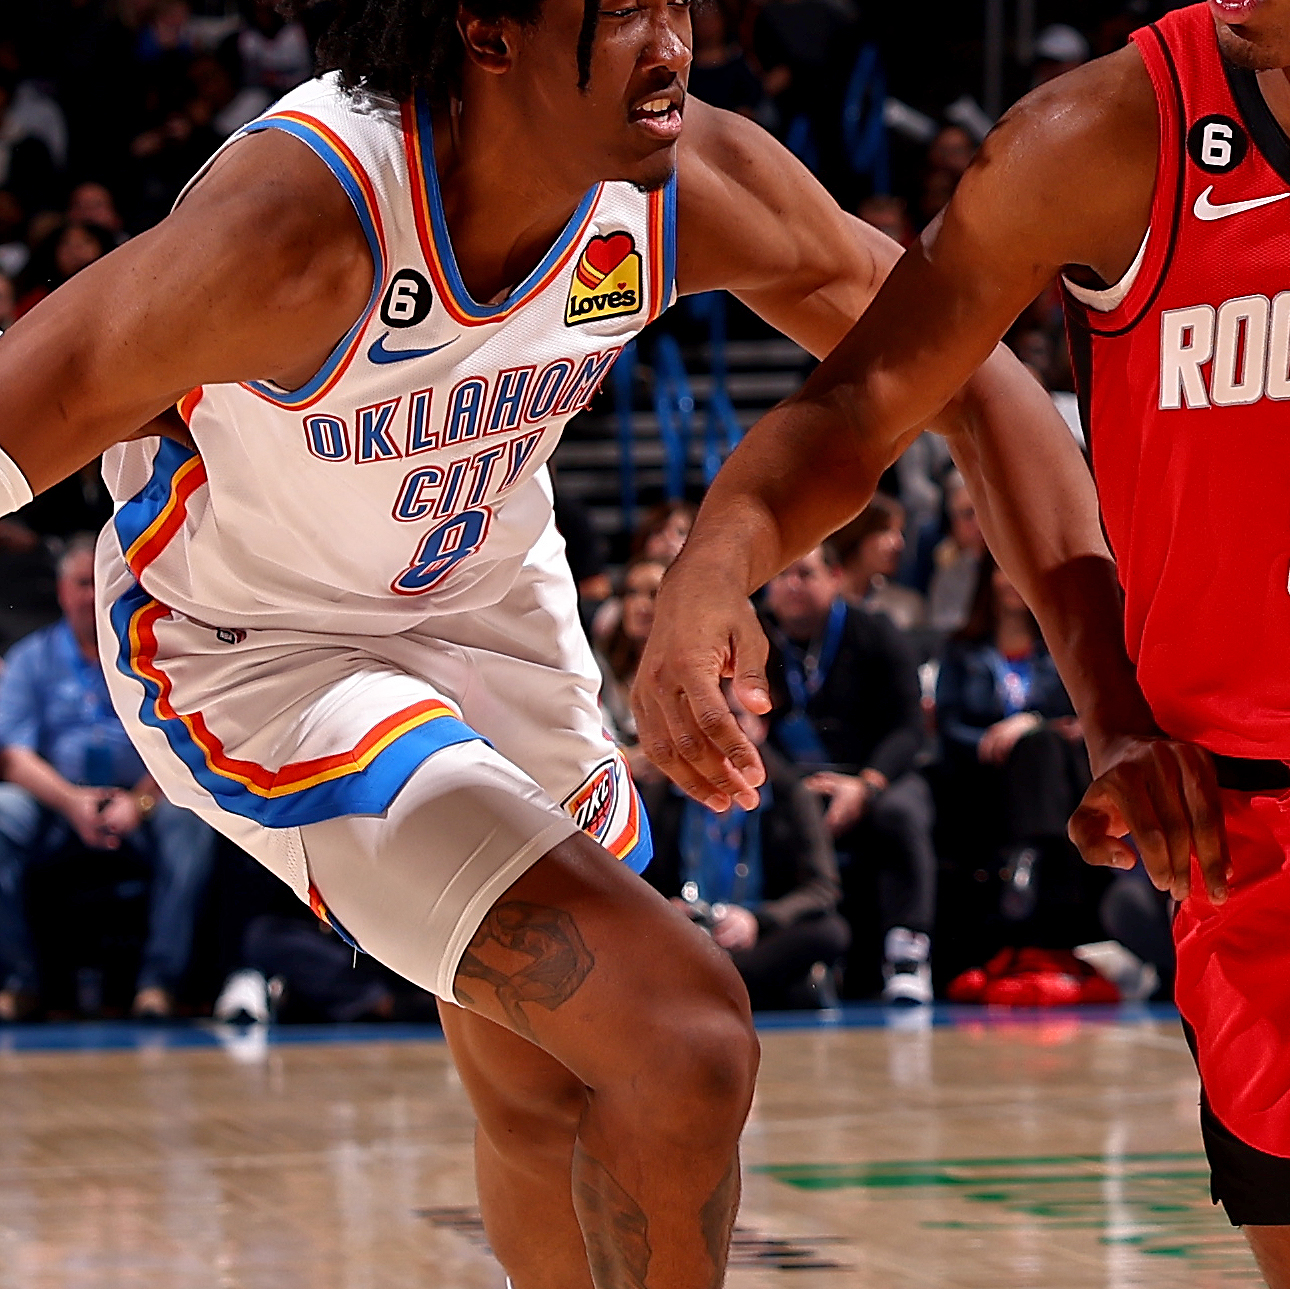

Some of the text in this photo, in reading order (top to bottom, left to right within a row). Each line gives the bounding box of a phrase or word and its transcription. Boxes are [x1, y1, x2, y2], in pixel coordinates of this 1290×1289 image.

[1202, 123, 1234, 166] 6
[386, 279, 420, 321] 6
[392, 427, 546, 522] CITY
